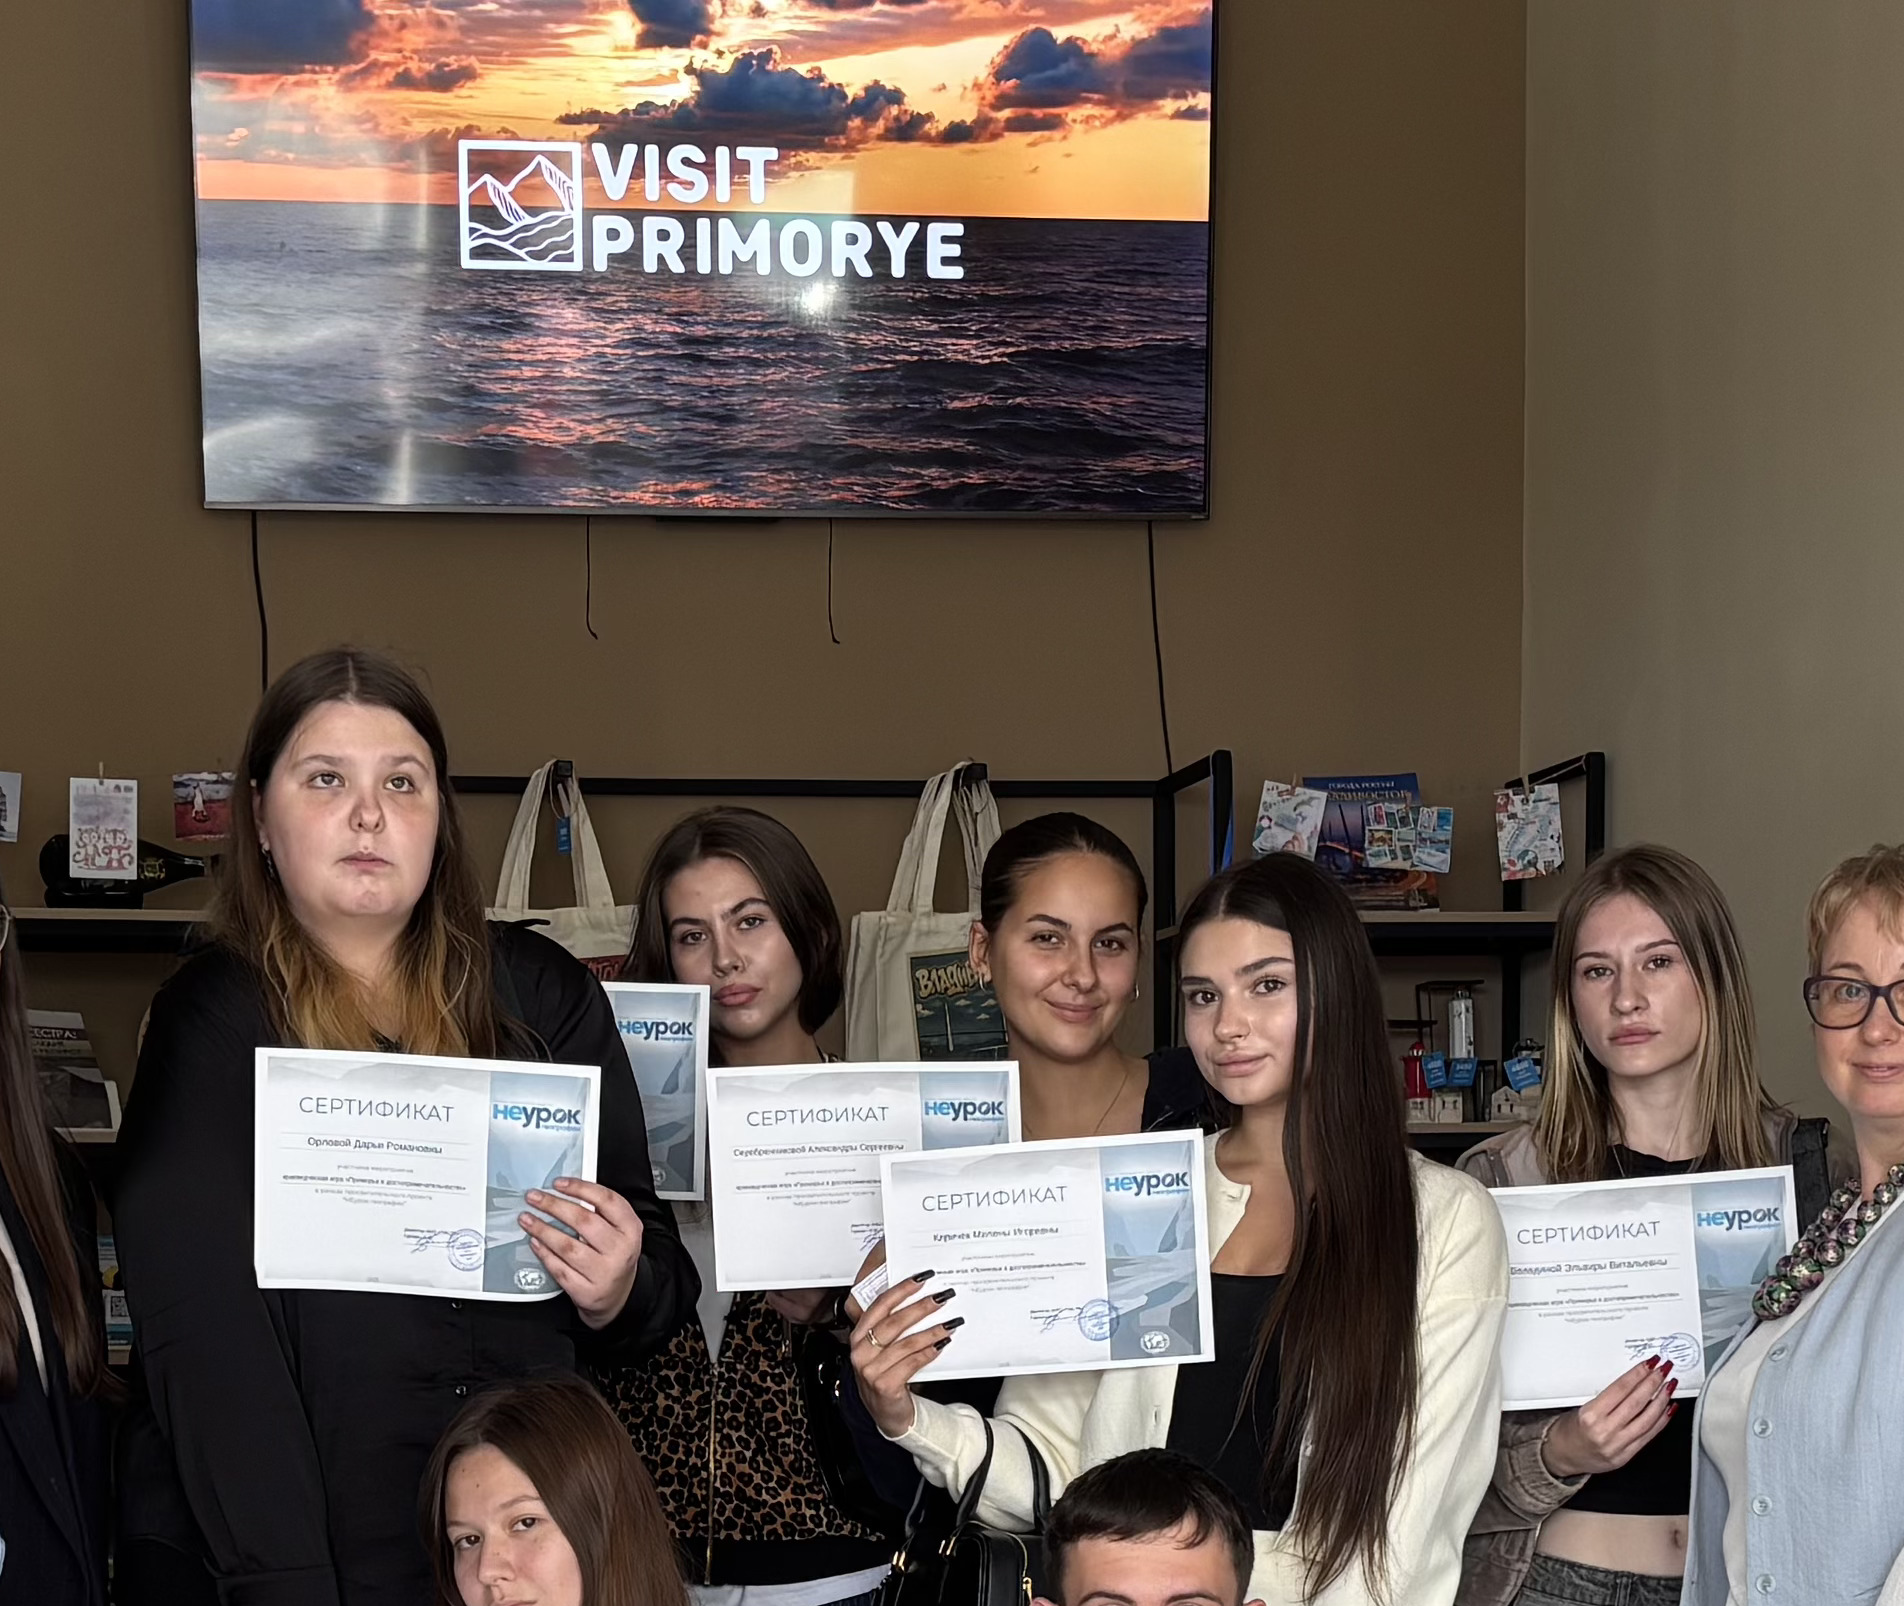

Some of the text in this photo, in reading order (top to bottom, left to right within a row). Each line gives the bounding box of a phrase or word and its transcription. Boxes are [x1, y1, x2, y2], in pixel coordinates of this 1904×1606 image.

[593, 142, 779, 204] VISIT
[593, 217, 965, 280] PRIMORYE
[617, 1018, 694, 1041] неурок
[298, 1095, 455, 1124] СЕРТИФИКАТ
[492, 1102, 582, 1130] неурок
[746, 1105, 890, 1128] СЕРТИФИКАТ
[924, 1099, 1005, 1121] неурок
[307, 1135, 352, 1150] Орловой
[1104, 1170, 1190, 1198] неурок
[922, 1185, 1068, 1212] СЕРТИФИКАТ
[1696, 1206, 1780, 1231] неурок
[1517, 1220, 1661, 1245] СЕРТИФИКАТ
